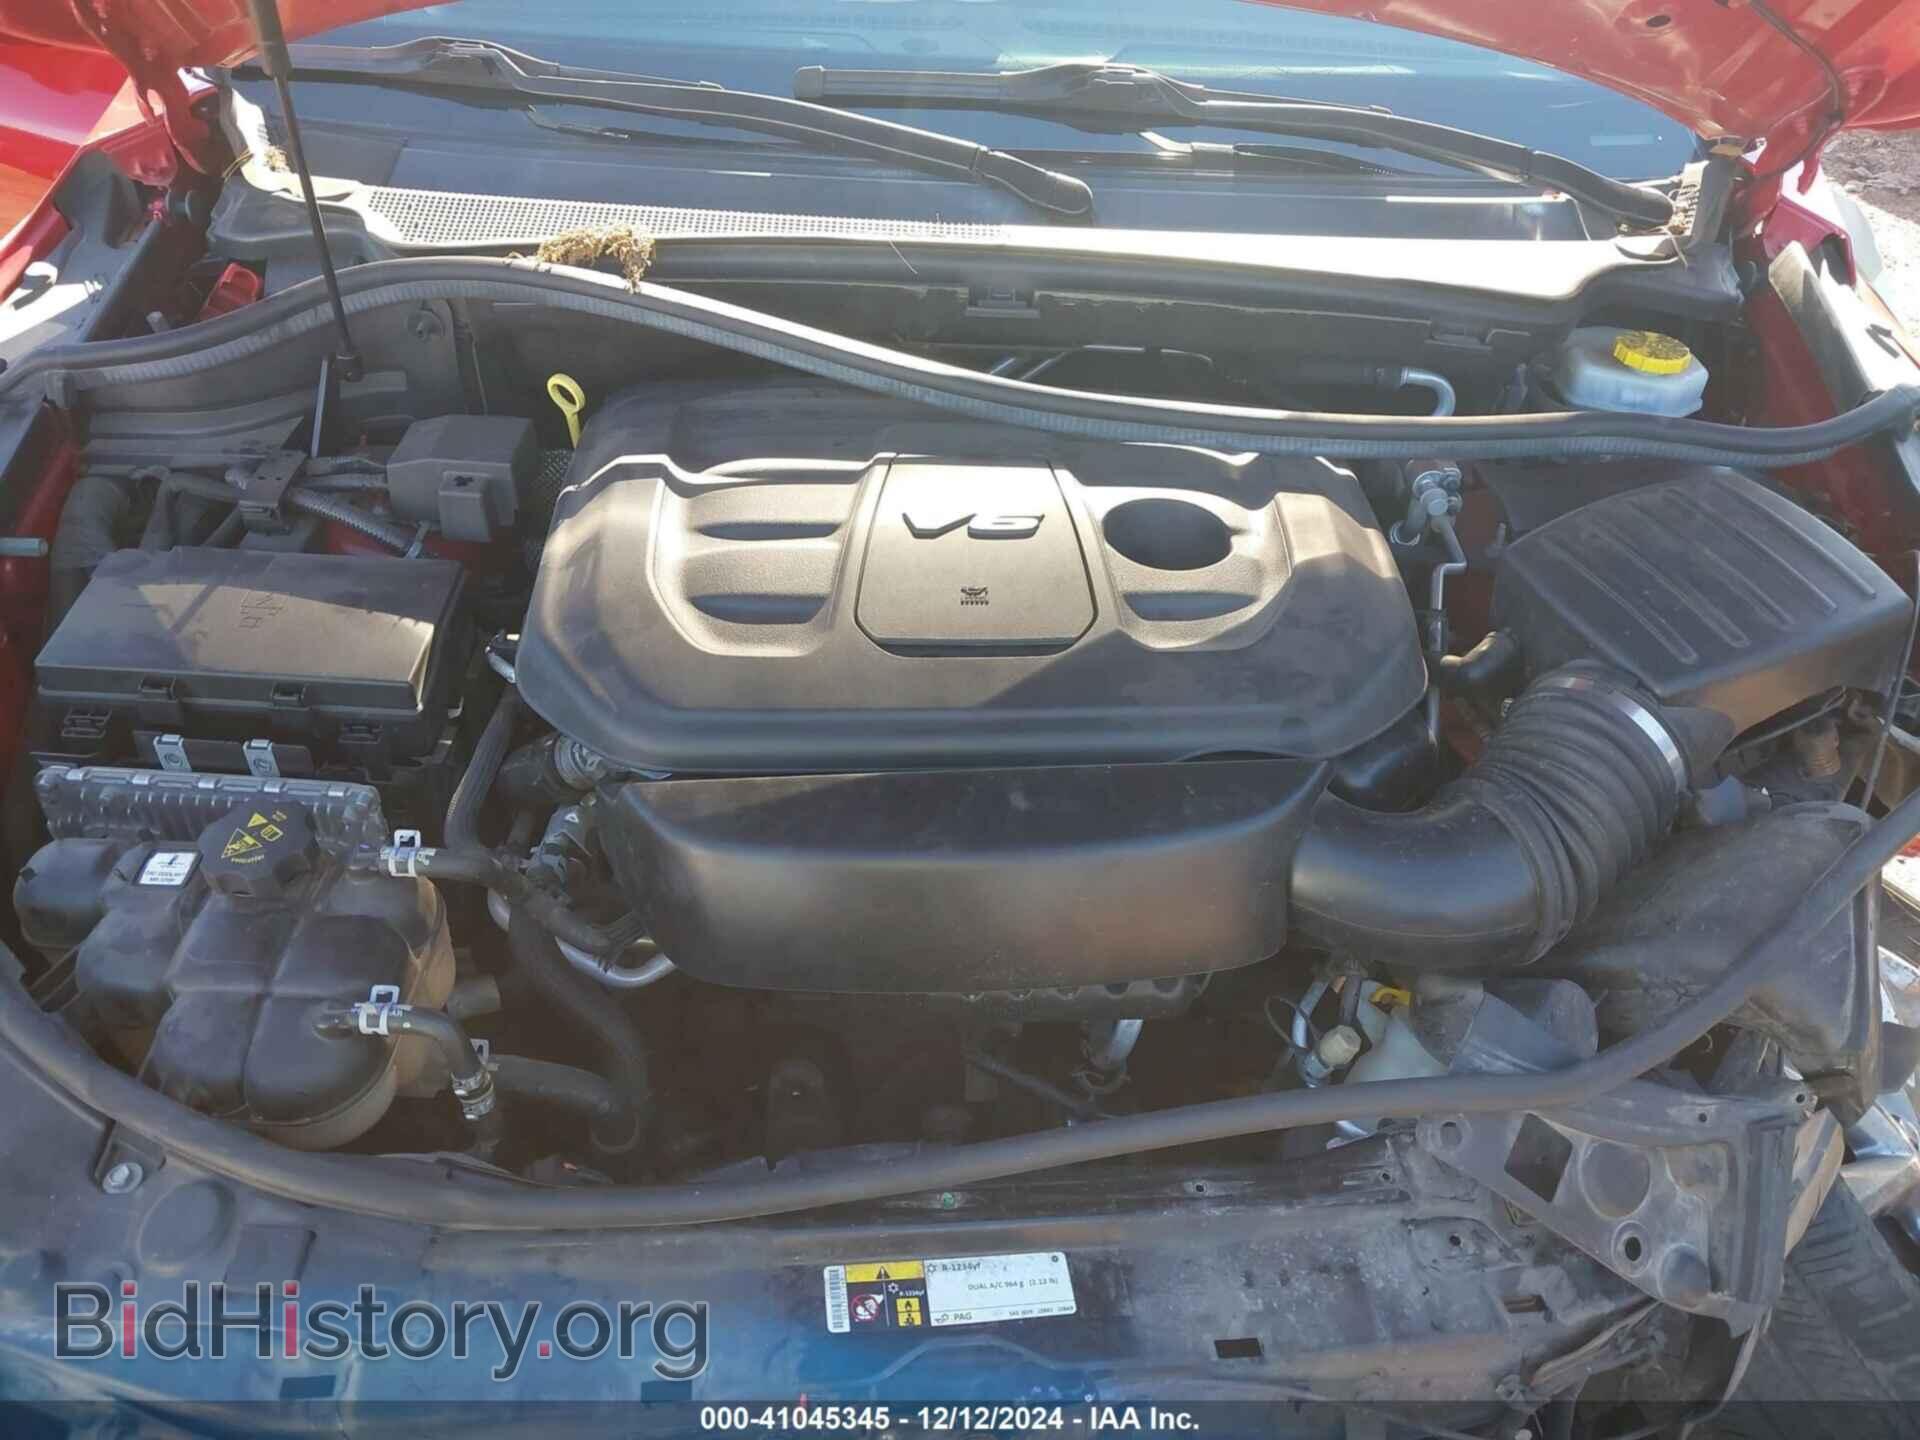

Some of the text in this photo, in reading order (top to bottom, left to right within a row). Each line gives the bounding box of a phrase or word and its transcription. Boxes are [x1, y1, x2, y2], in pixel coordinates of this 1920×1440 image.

[901, 510, 1046, 540] V6
[967, 1281, 987, 1290] DUAL
[989, 1280, 1003, 1290] A/C
[953, 1311, 973, 1321] PAG
